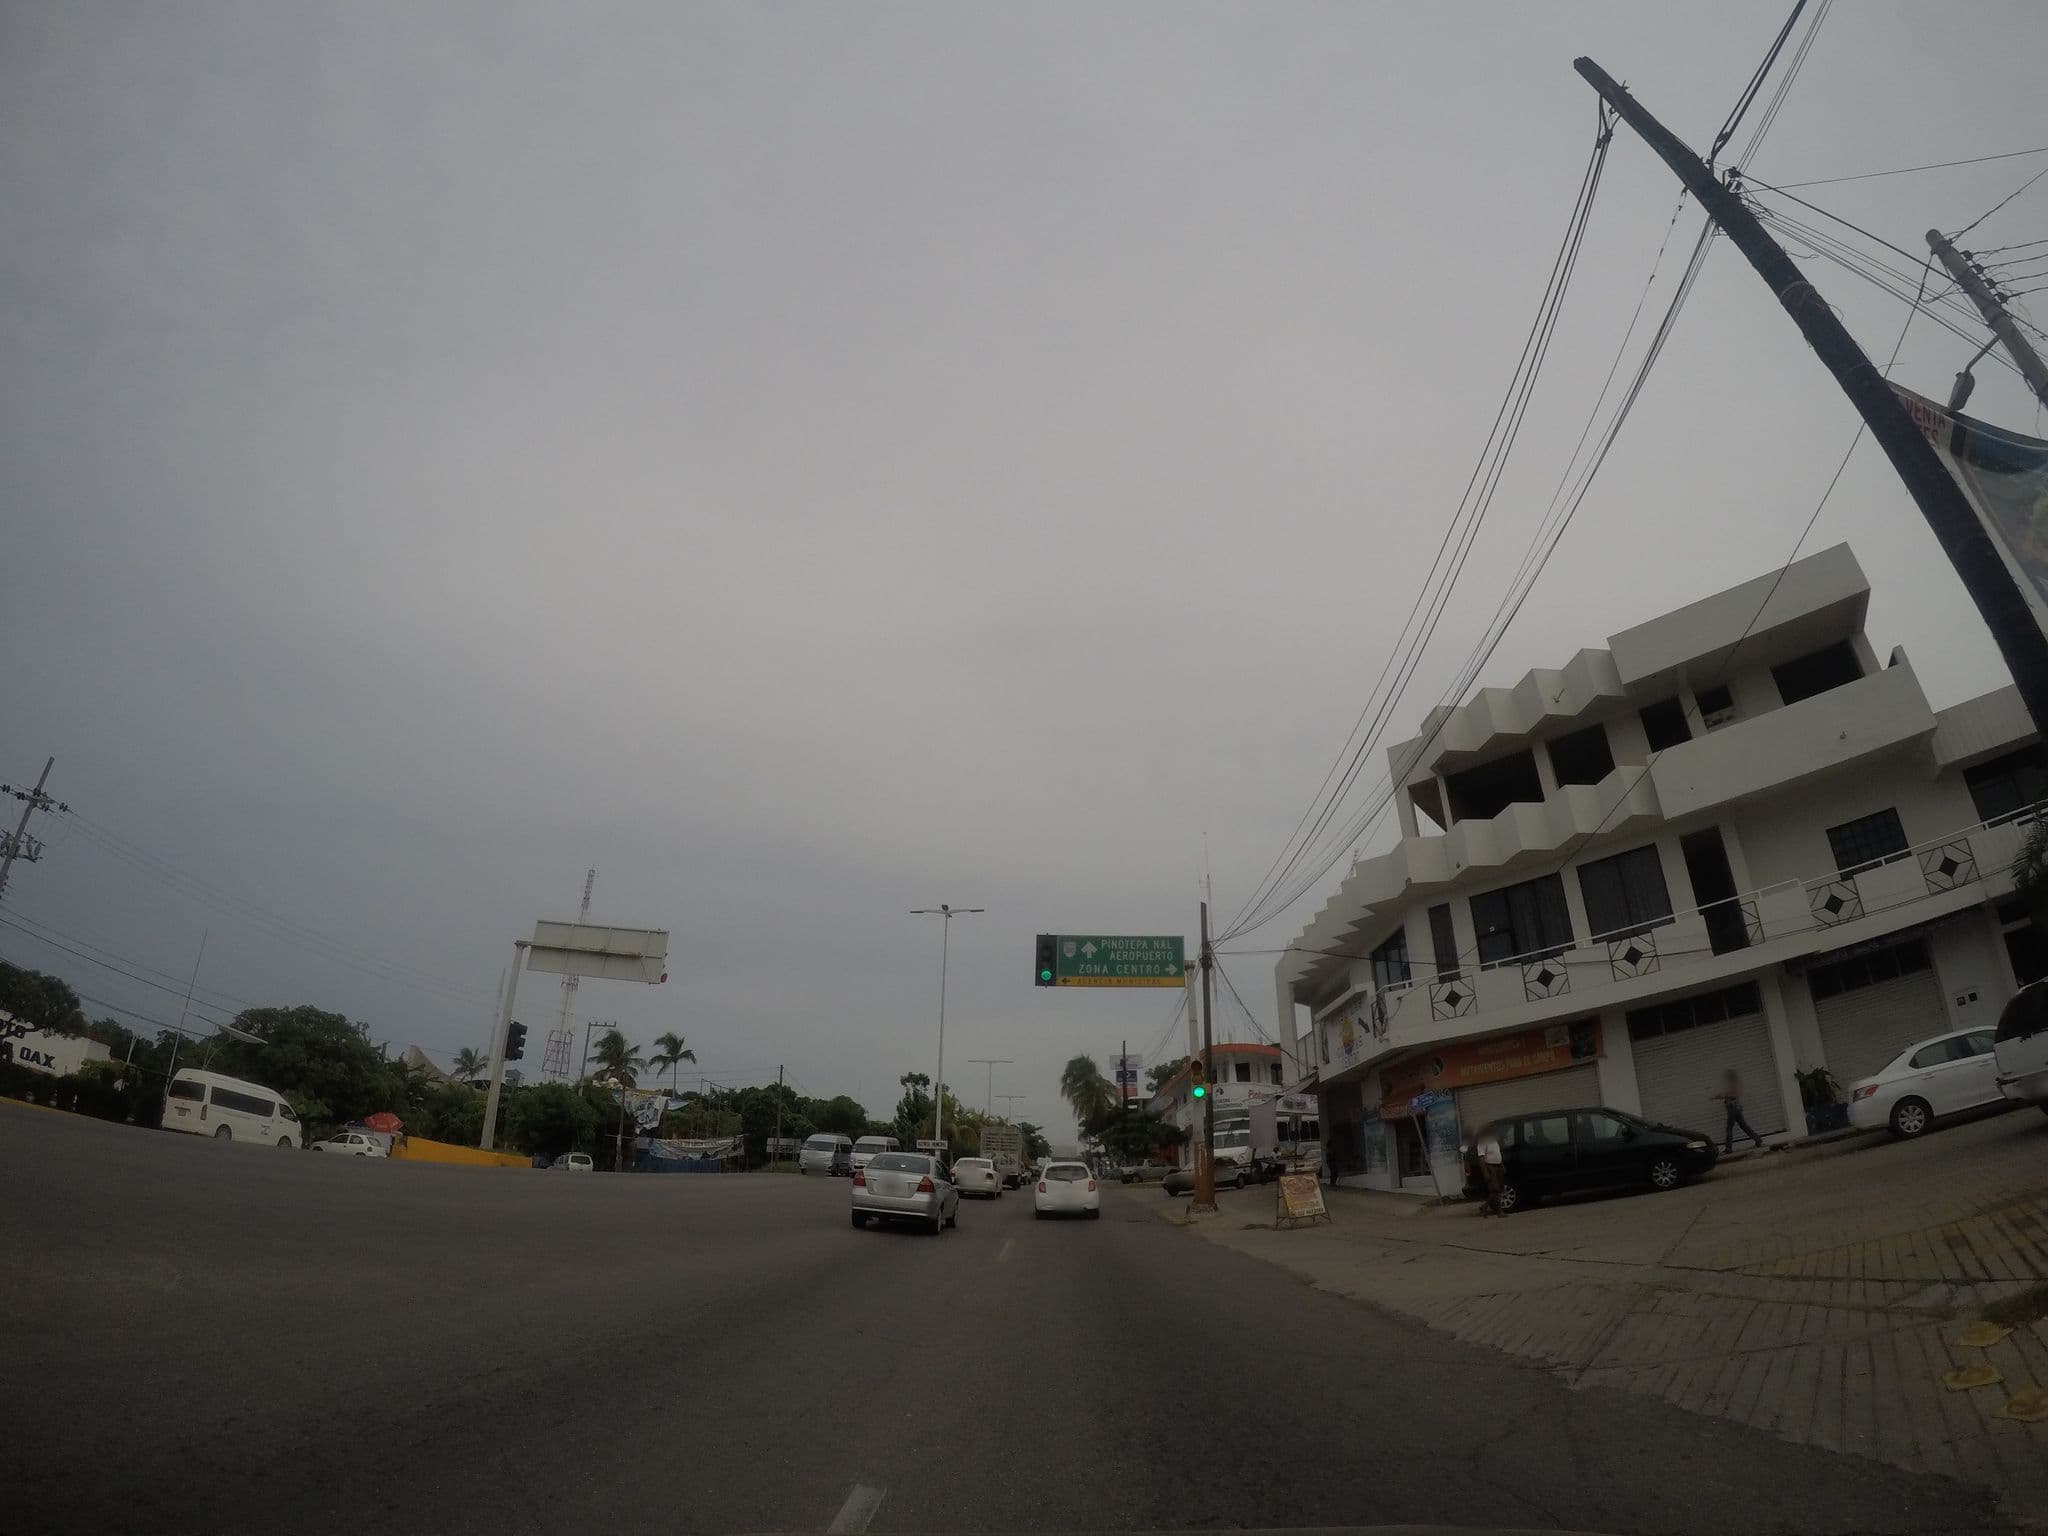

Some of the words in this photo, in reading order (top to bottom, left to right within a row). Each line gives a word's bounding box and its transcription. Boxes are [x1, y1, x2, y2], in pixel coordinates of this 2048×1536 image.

[1101, 939, 1148, 950] PINOTEPA
[1153, 940, 1173, 950] NAL
[1109, 951, 1174, 961] AEROPUERTO
[1078, 963, 1109, 975] ZONA
[1116, 964, 1161, 975] CENTRO
